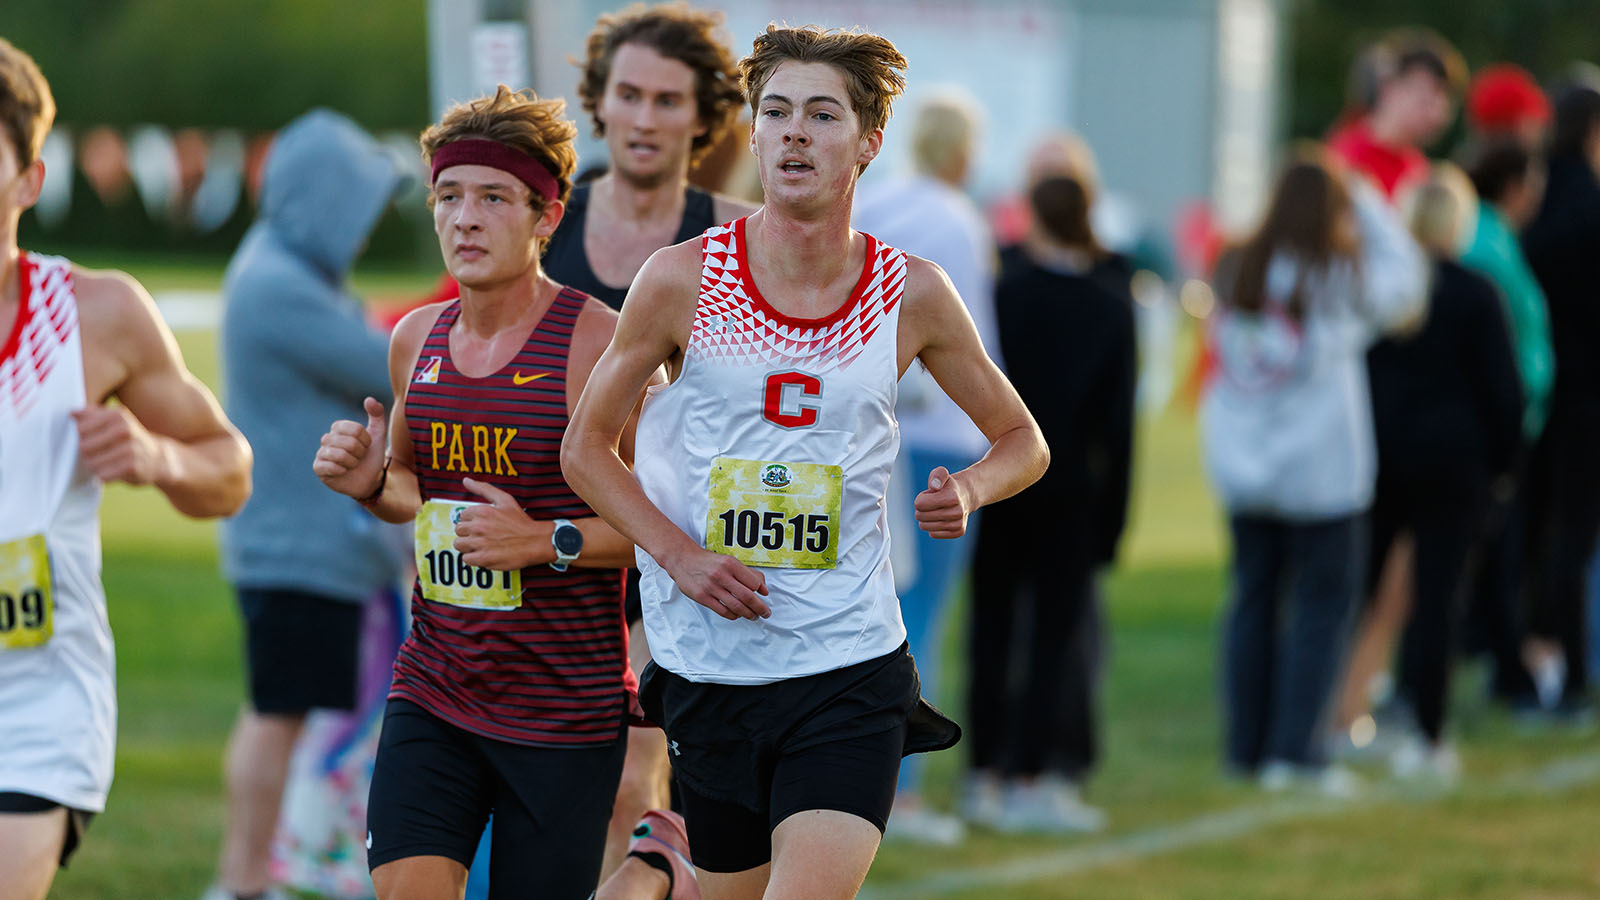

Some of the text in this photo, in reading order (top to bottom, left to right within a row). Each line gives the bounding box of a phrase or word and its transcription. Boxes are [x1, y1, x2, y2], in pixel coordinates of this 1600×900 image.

[761, 368, 824, 432] C
[430, 421, 518, 476] PARK
[718, 508, 830, 553] 10515
